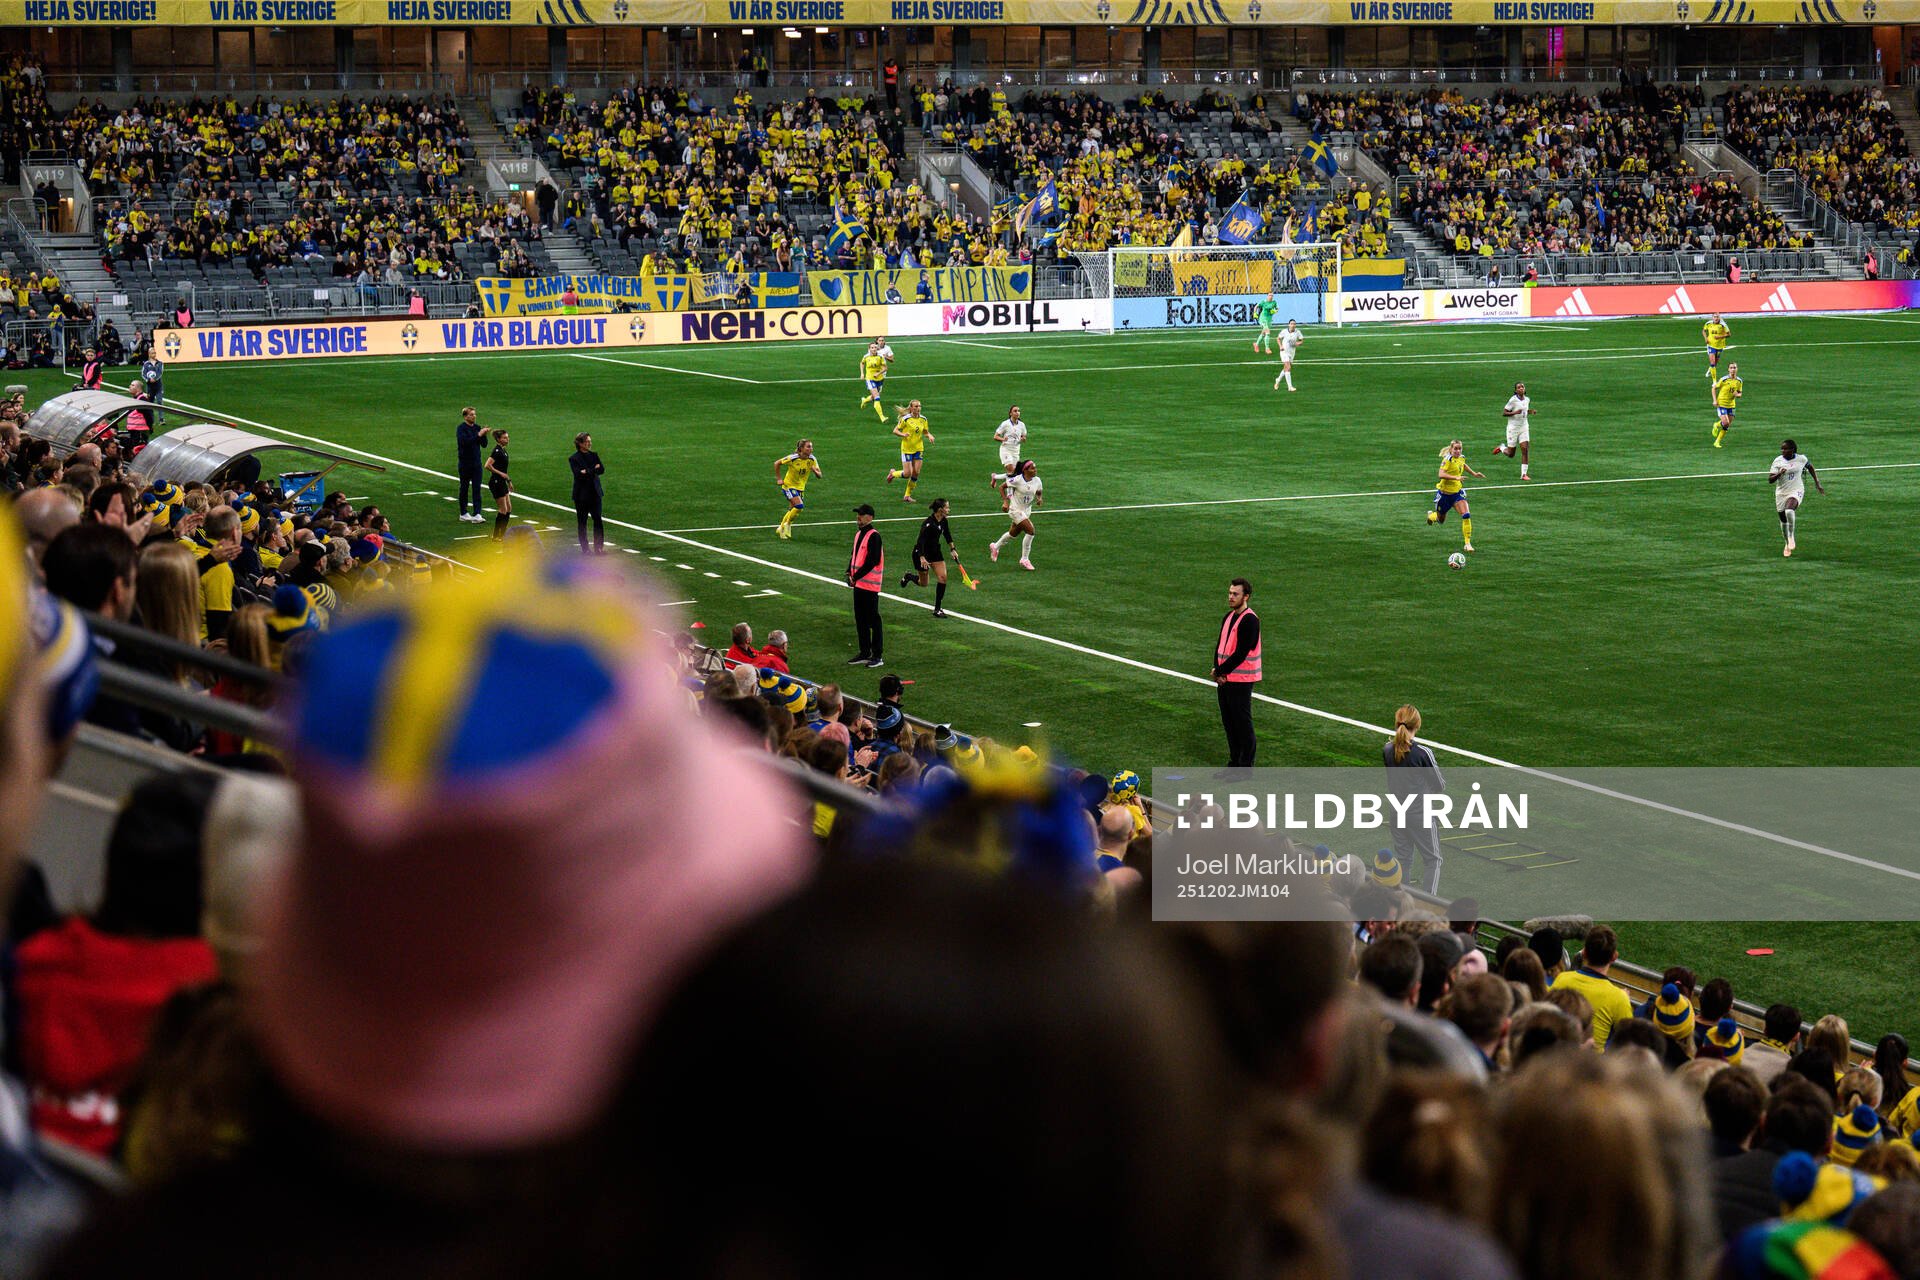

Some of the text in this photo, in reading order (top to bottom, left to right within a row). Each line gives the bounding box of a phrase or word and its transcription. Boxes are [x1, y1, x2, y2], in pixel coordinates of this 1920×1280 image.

[26, 1, 157, 21] HEJA SVERIGE!
[211, 1, 337, 21] VI ÄR SVERIGE
[388, 1, 511, 21] HEJA SVERIGE!
[729, 1, 844, 20] VI ÄR SVERIGE
[891, 1, 1004, 20] HEJA SVERIGE!
[1350, 2, 1453, 20] VI ÄR SVERIGE
[1494, 2, 1594, 20] HEJA SVERIGE!
[501, 162, 529, 174] A118
[930, 155, 955, 168] A117
[34, 169, 65, 180] A119
[524, 274, 642, 298] CAMP SWEDEN
[843, 267, 1007, 305] TACK EMPAN
[527, 301, 554, 312] VINNER
[1357, 293, 1420, 311] weber
[1457, 290, 1518, 308] weber
[942, 302, 1060, 332] MOBILL
[197, 326, 368, 358] VI ÄR SVERIGE
[442, 318, 608, 349] VI ÄR BLÅGULT
